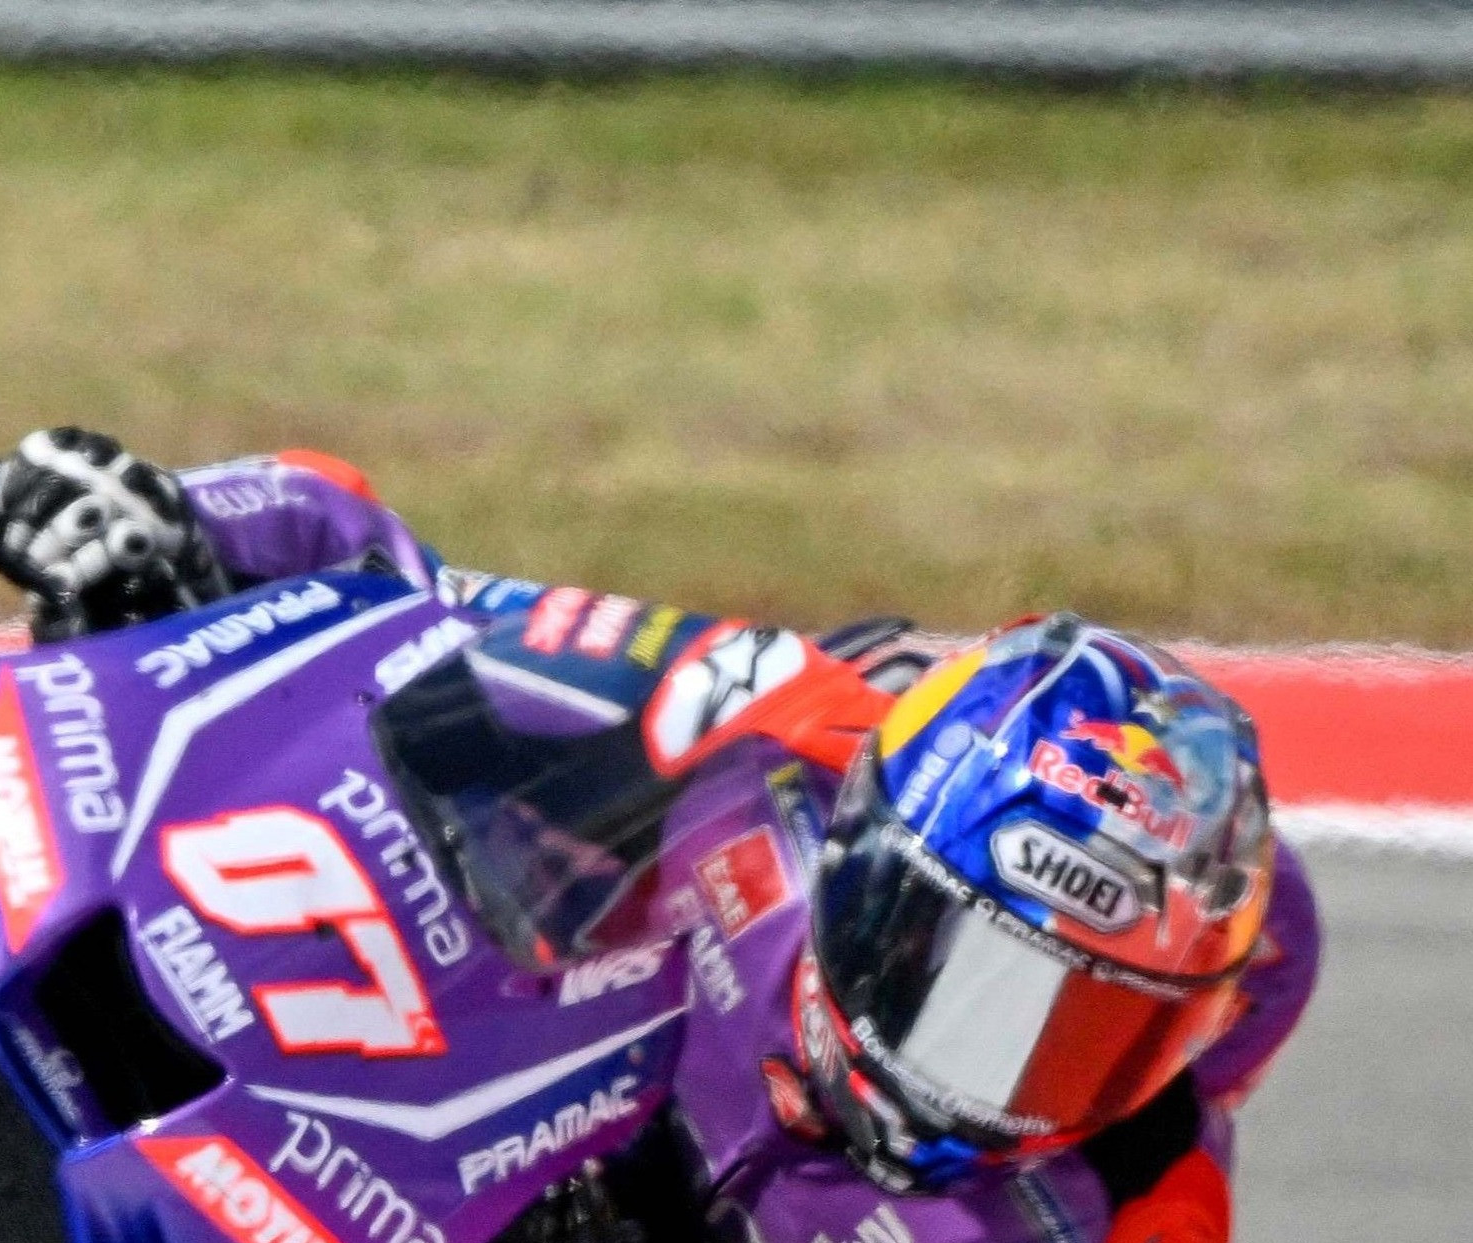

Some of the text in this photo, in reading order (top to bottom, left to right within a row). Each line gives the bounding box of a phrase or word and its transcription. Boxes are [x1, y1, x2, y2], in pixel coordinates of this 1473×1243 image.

[134, 579, 343, 691] PRAMAC
[9, 652, 128, 835] prima
[159, 803, 449, 1058] 07
[316, 767, 471, 967] prima
[1012, 836, 1125, 918] SHOEI
[137, 903, 256, 1042] FIAMM
[457, 1072, 640, 1195] PRAMAC
